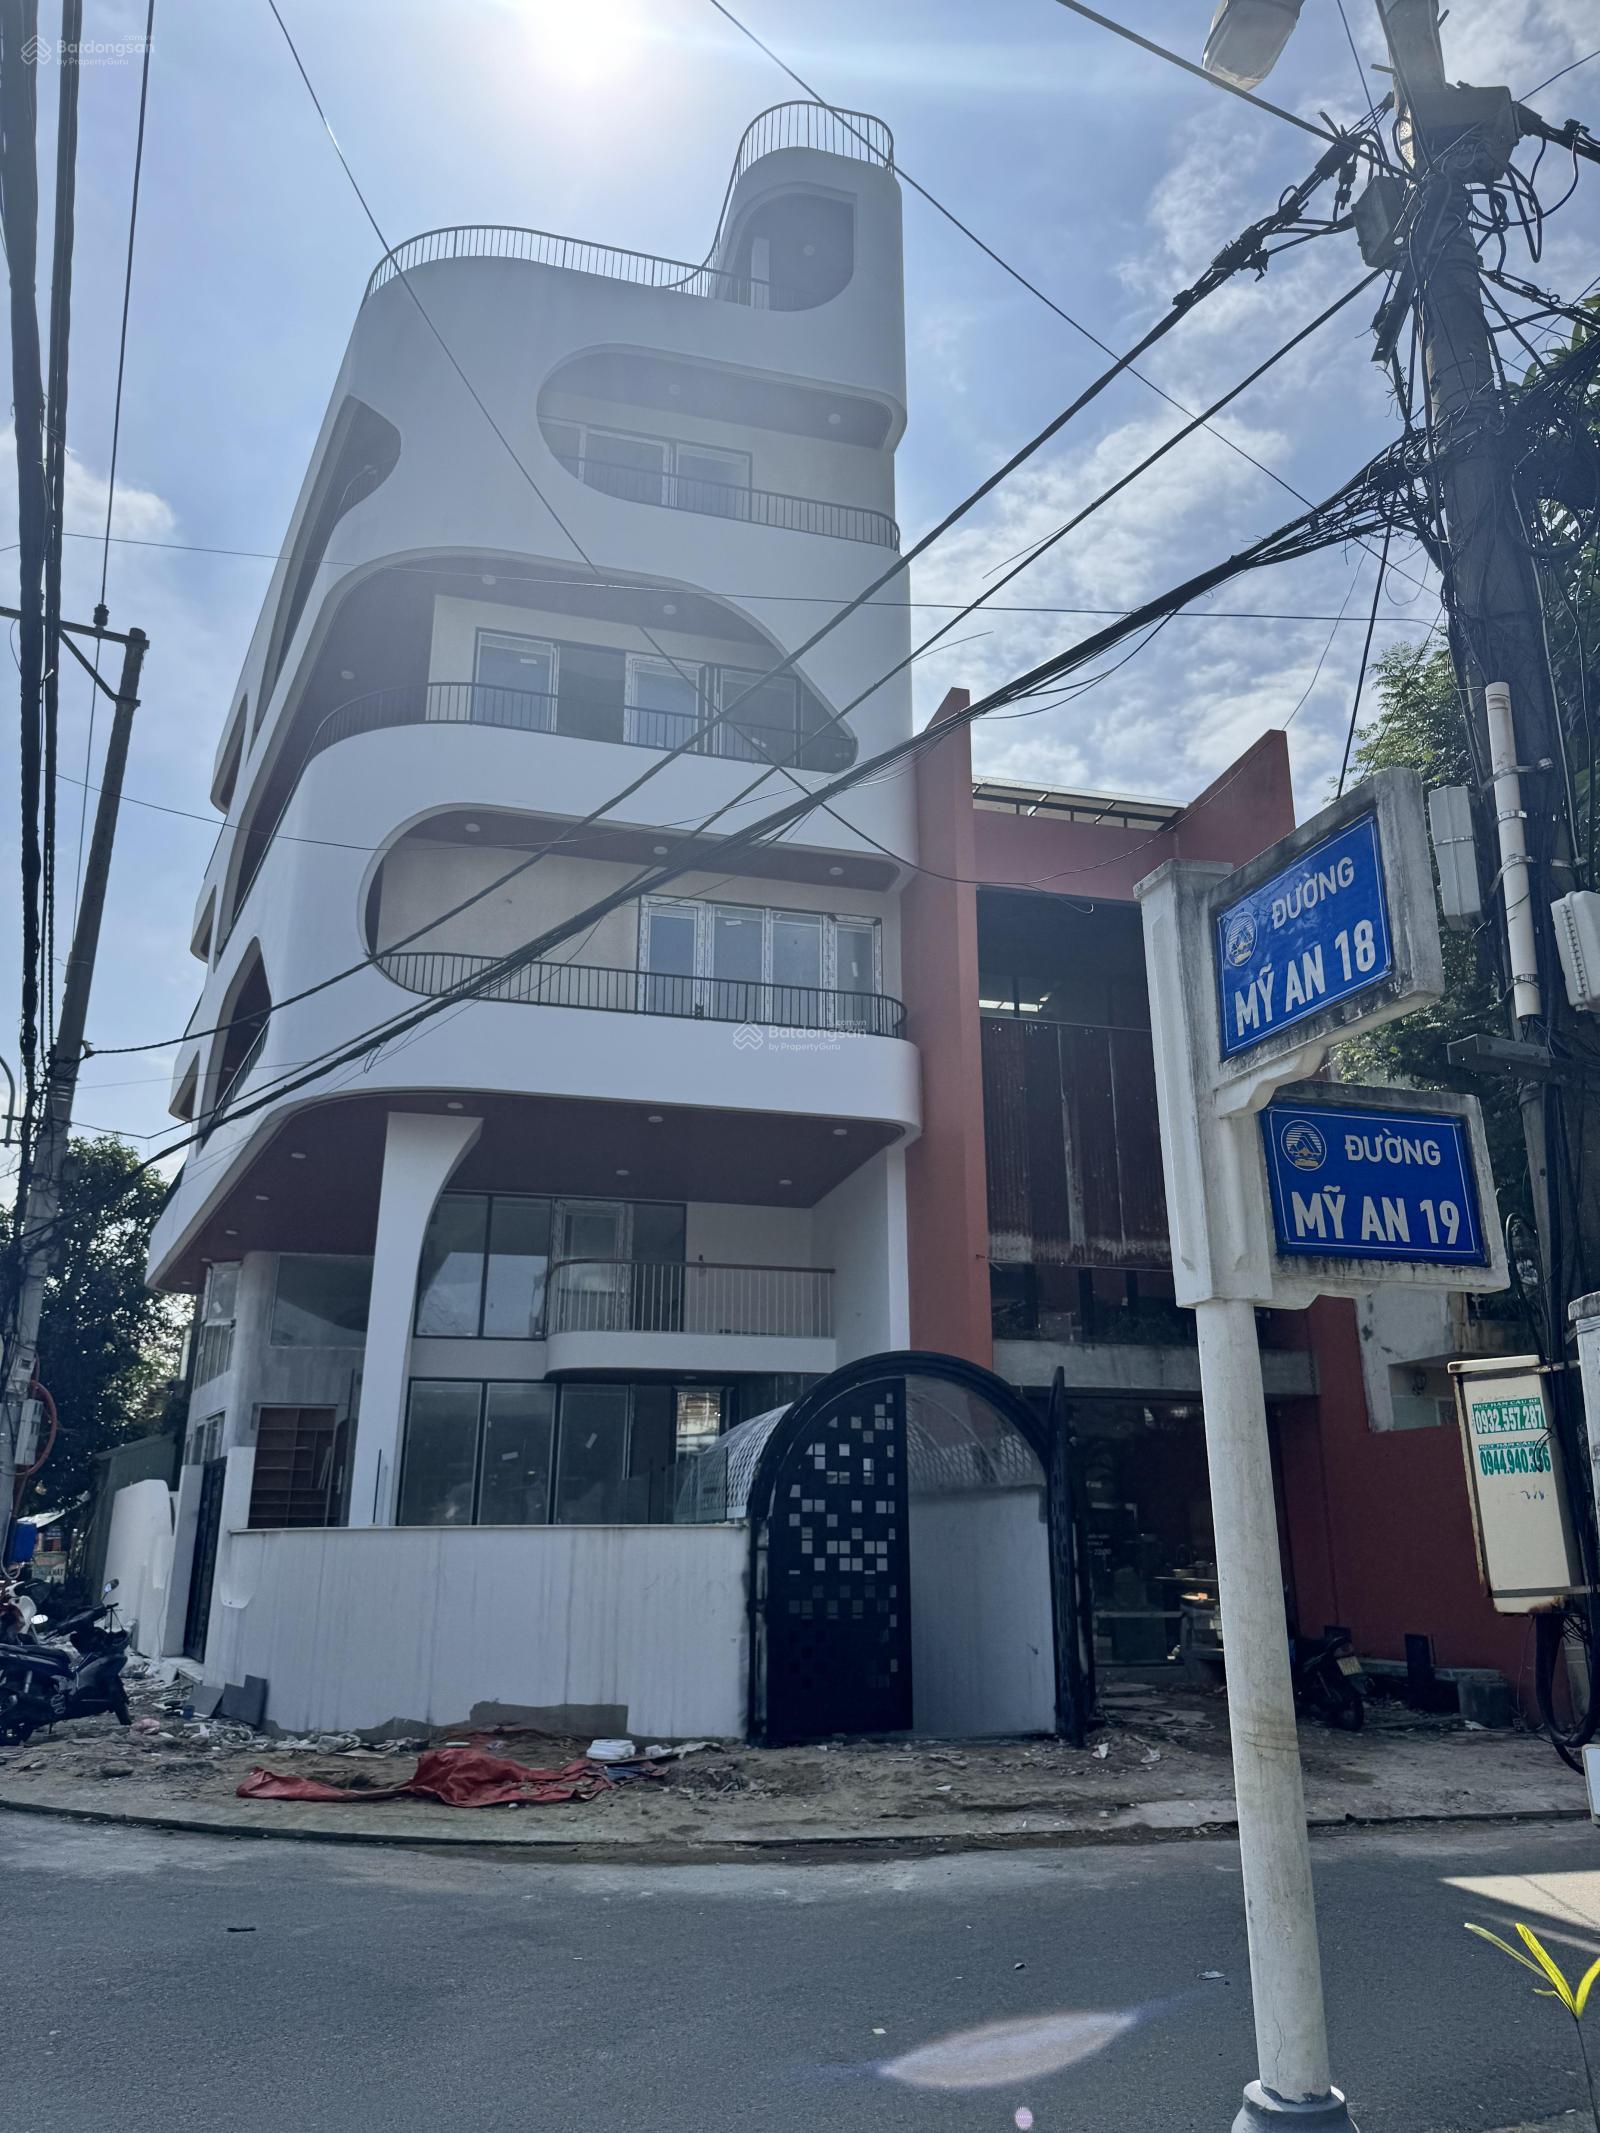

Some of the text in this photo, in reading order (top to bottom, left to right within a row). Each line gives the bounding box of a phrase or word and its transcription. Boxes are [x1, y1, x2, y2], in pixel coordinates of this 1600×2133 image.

[1271, 856, 1355, 930] ĐƯỜNG
[1234, 919, 1376, 1037] MỸ AN 18
[1344, 1128, 1441, 1166] ĐƯỜNG
[1291, 1185, 1460, 1245] MỸ AN 19
[1474, 1404, 1543, 1433] 0932.557.287
